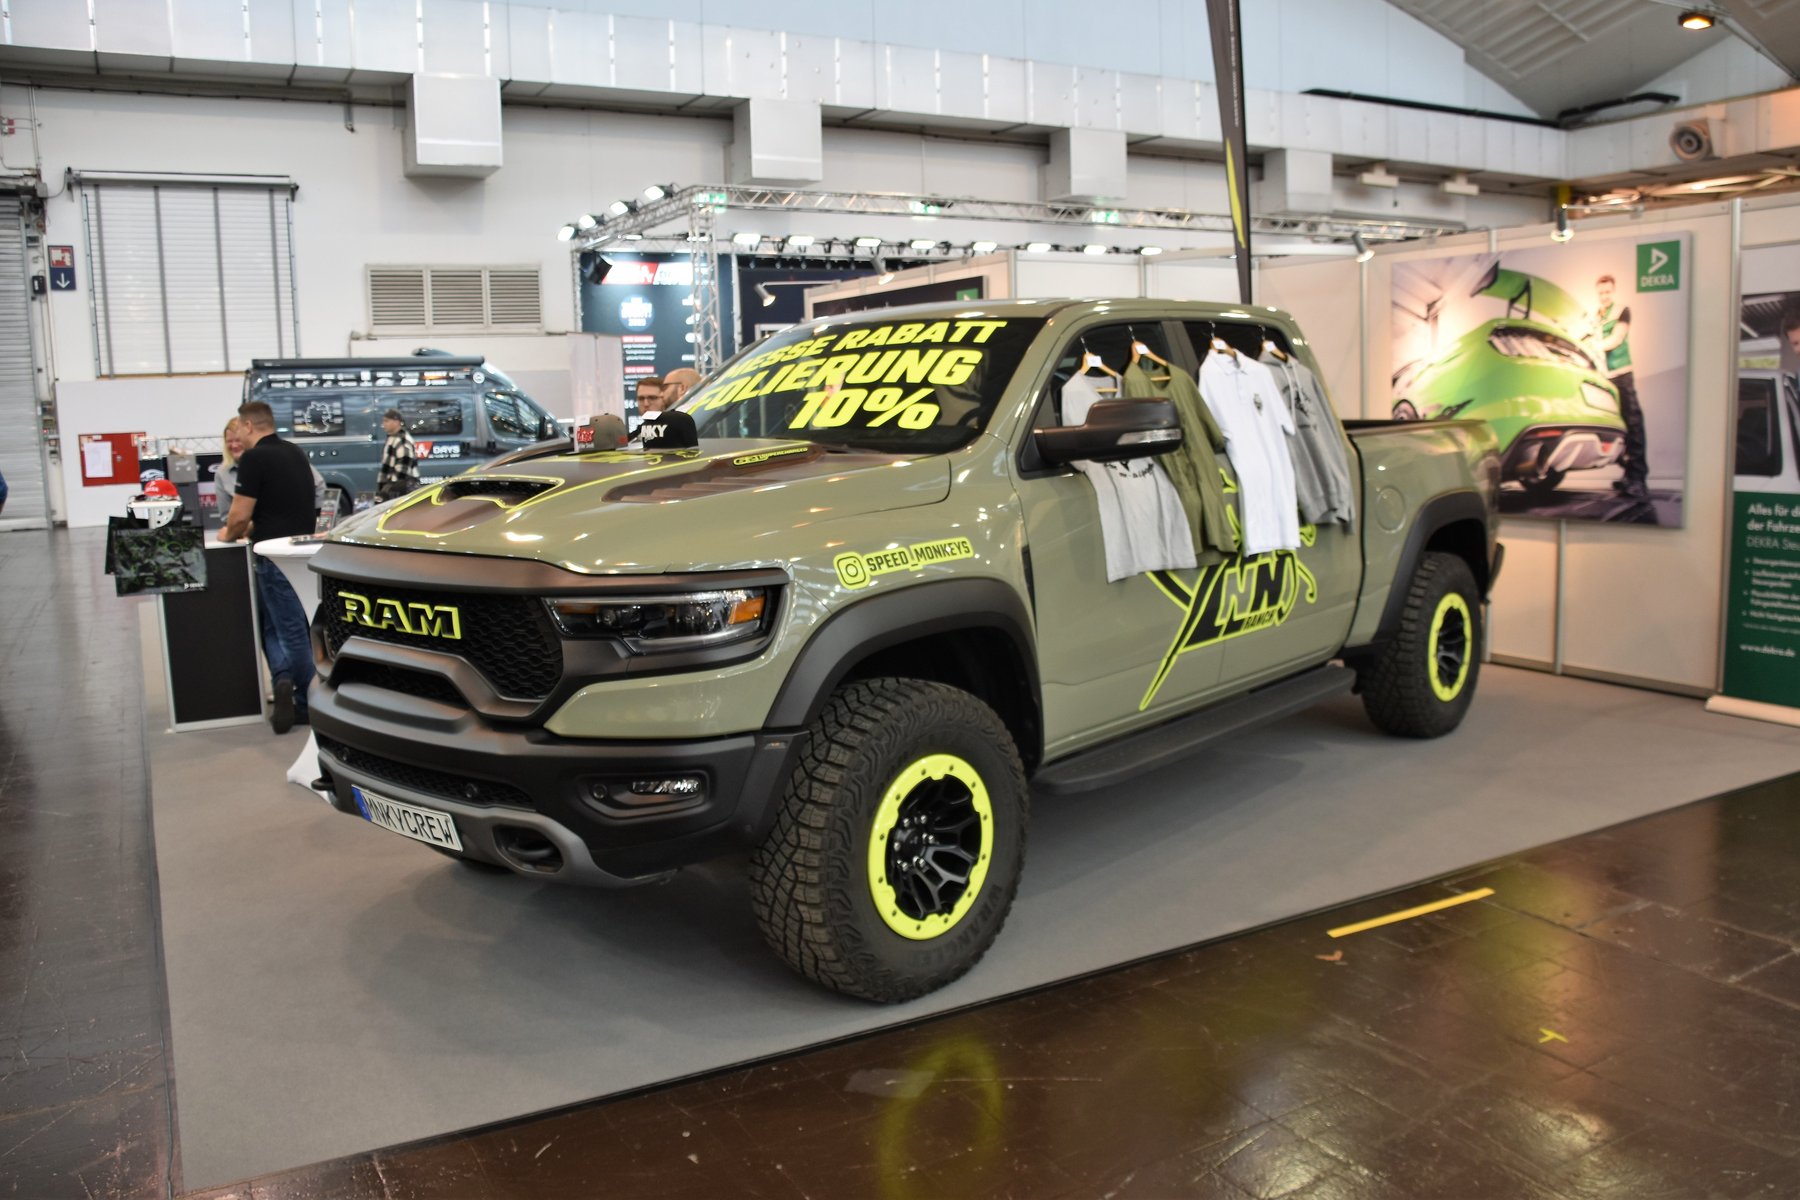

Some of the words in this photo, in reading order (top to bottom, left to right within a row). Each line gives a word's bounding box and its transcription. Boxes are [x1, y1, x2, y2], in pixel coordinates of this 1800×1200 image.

[1640, 274, 1675, 288] DEKRA
[833, 320, 1008, 350] RABATT
[687, 349, 983, 415] FOLIERUNG
[788, 387, 940, 431] 10%
[1746, 518, 1765, 531] der
[1748, 503, 1773, 516] Alles
[1774, 503, 1790, 517] für
[1746, 535, 1780, 549] DEKRA
[337, 591, 462, 640] RAM
[362, 795, 455, 846] MNKYCREW
